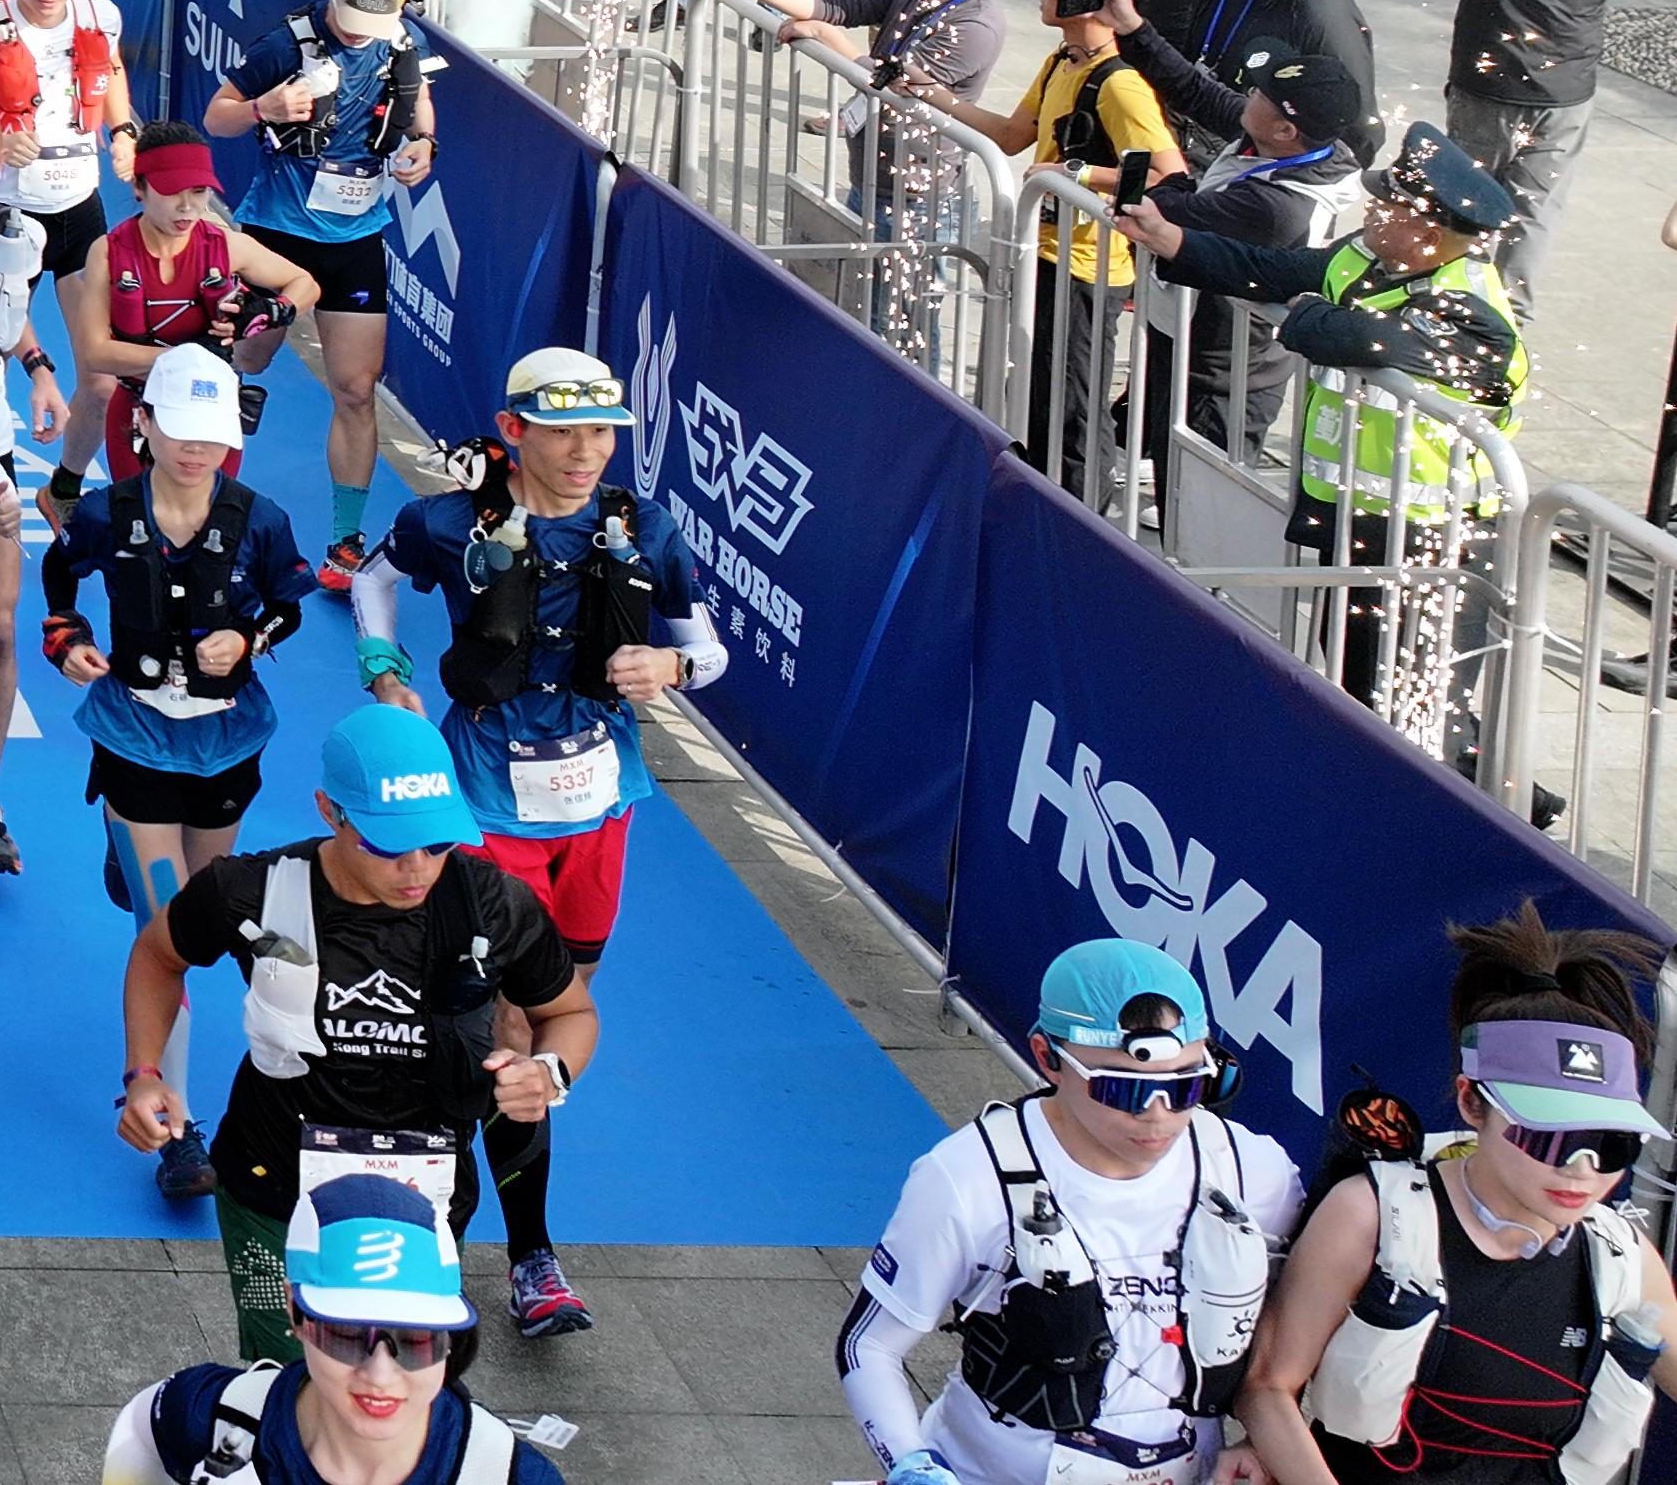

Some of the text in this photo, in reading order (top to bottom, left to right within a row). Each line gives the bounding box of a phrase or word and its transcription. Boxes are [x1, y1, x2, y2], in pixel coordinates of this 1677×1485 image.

[394, 296, 452, 369] SPORTS GROUP
[715, 533, 803, 648] HORSE
[381, 772, 451, 803] HOKA
[549, 768, 596, 793] 5337
[1008, 701, 1325, 1117] HOKA
[374, 1043, 410, 1056] Trail
[364, 1158, 399, 1171] MXM
[1126, 1468, 1161, 1483] MXM
